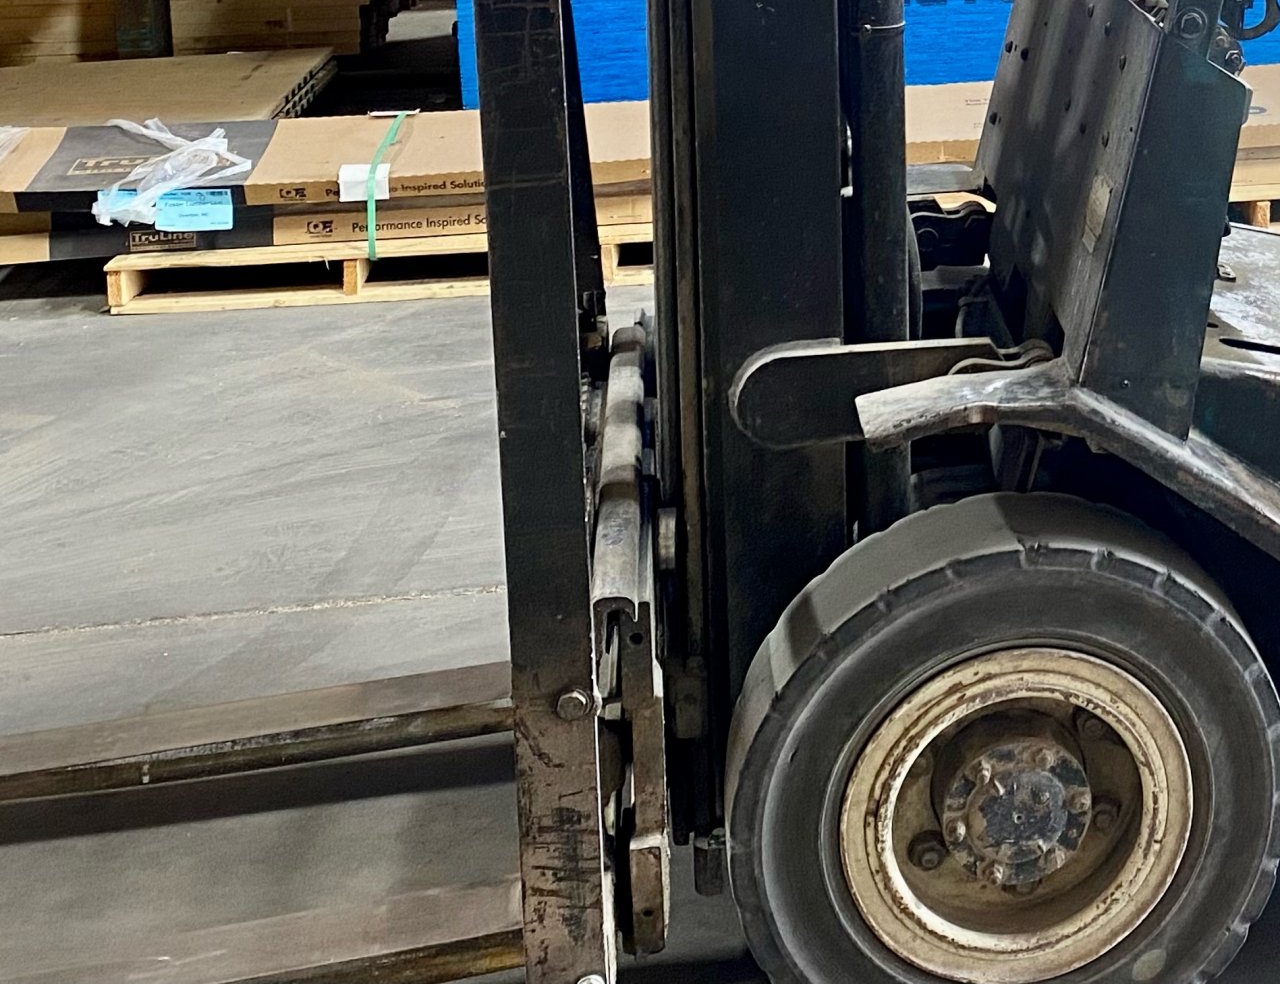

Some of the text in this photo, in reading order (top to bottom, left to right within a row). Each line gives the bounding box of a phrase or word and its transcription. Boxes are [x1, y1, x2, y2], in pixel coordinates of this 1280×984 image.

[401, 180, 446, 194] Inspired
[352, 219, 422, 233] Perormance
[426, 214, 470, 230] Inspired
